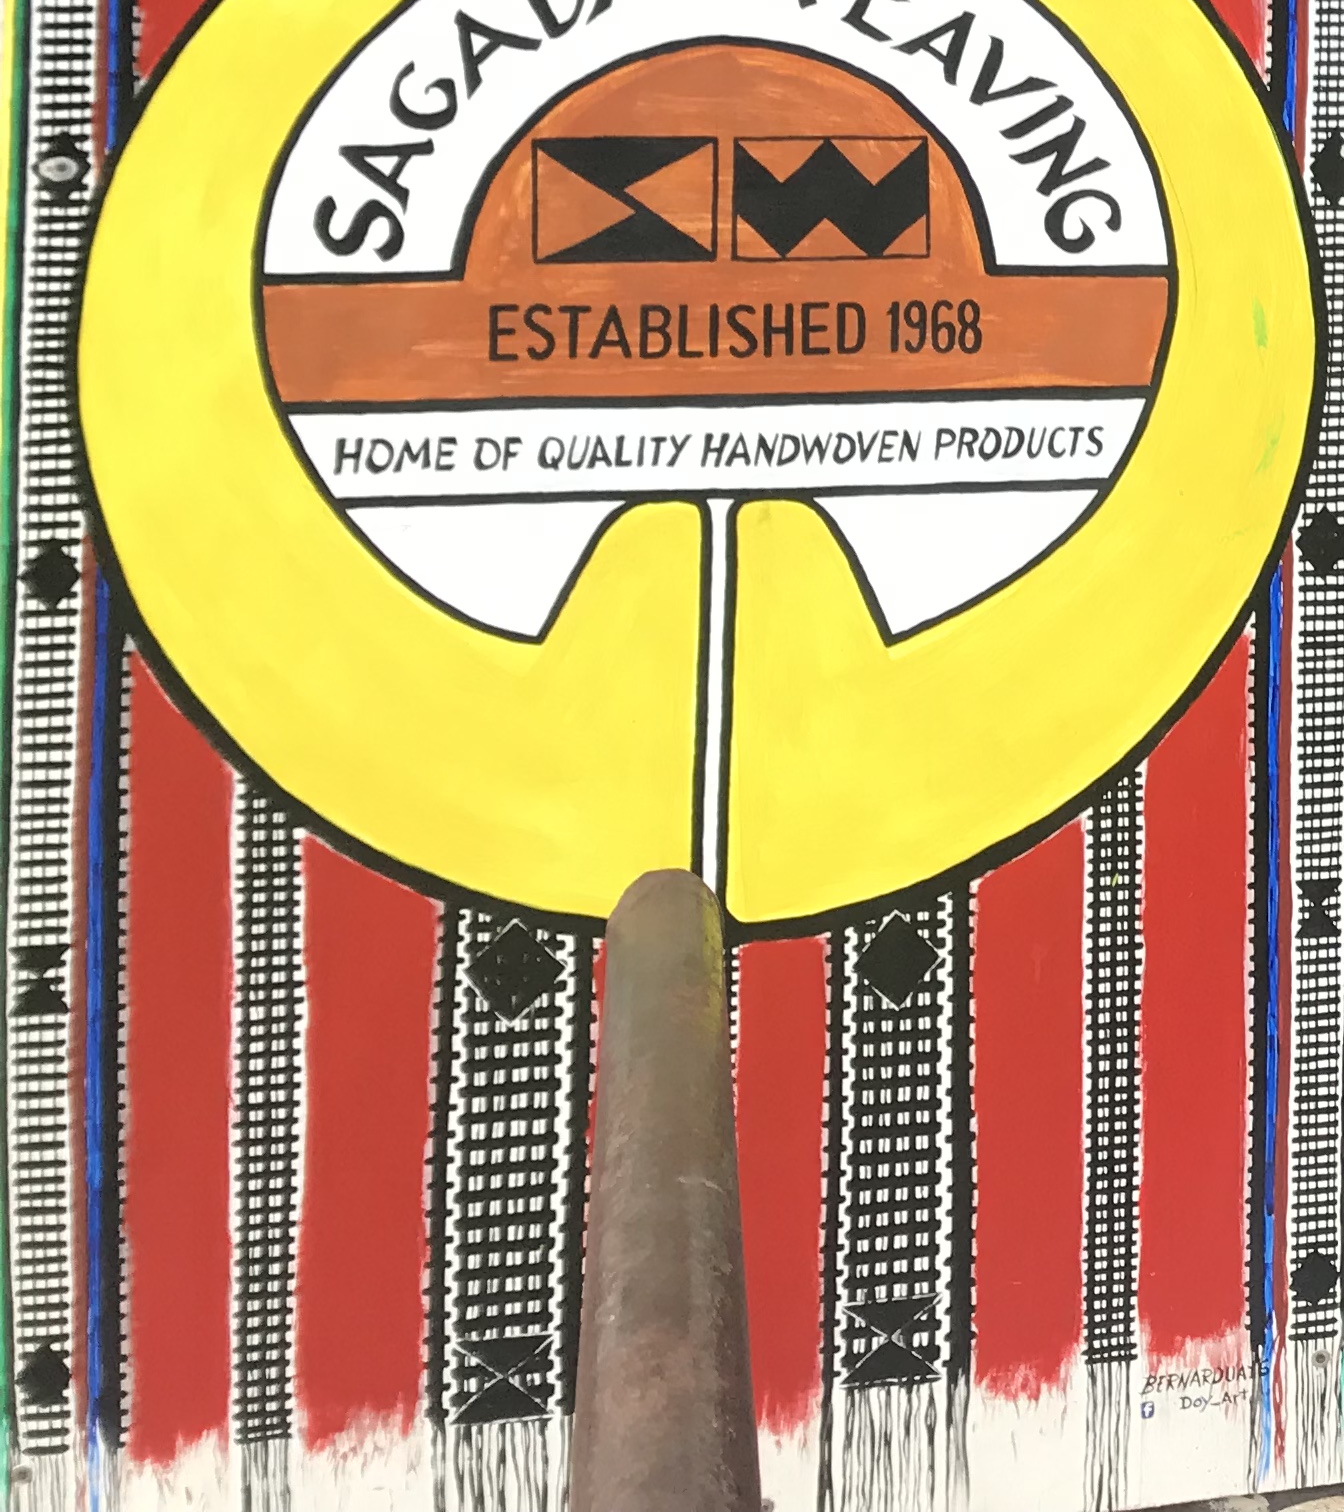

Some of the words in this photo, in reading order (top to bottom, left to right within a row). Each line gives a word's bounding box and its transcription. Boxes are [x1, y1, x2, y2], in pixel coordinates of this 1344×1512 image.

[488, 302, 867, 362] ESTABLISHED
[886, 299, 984, 354] 1968
[334, 437, 457, 475] HOME
[474, 436, 523, 471] OF
[537, 434, 691, 471] QUALITY
[701, 430, 919, 468] HANDWOVEN
[934, 426, 1104, 462] PRODUCTS
